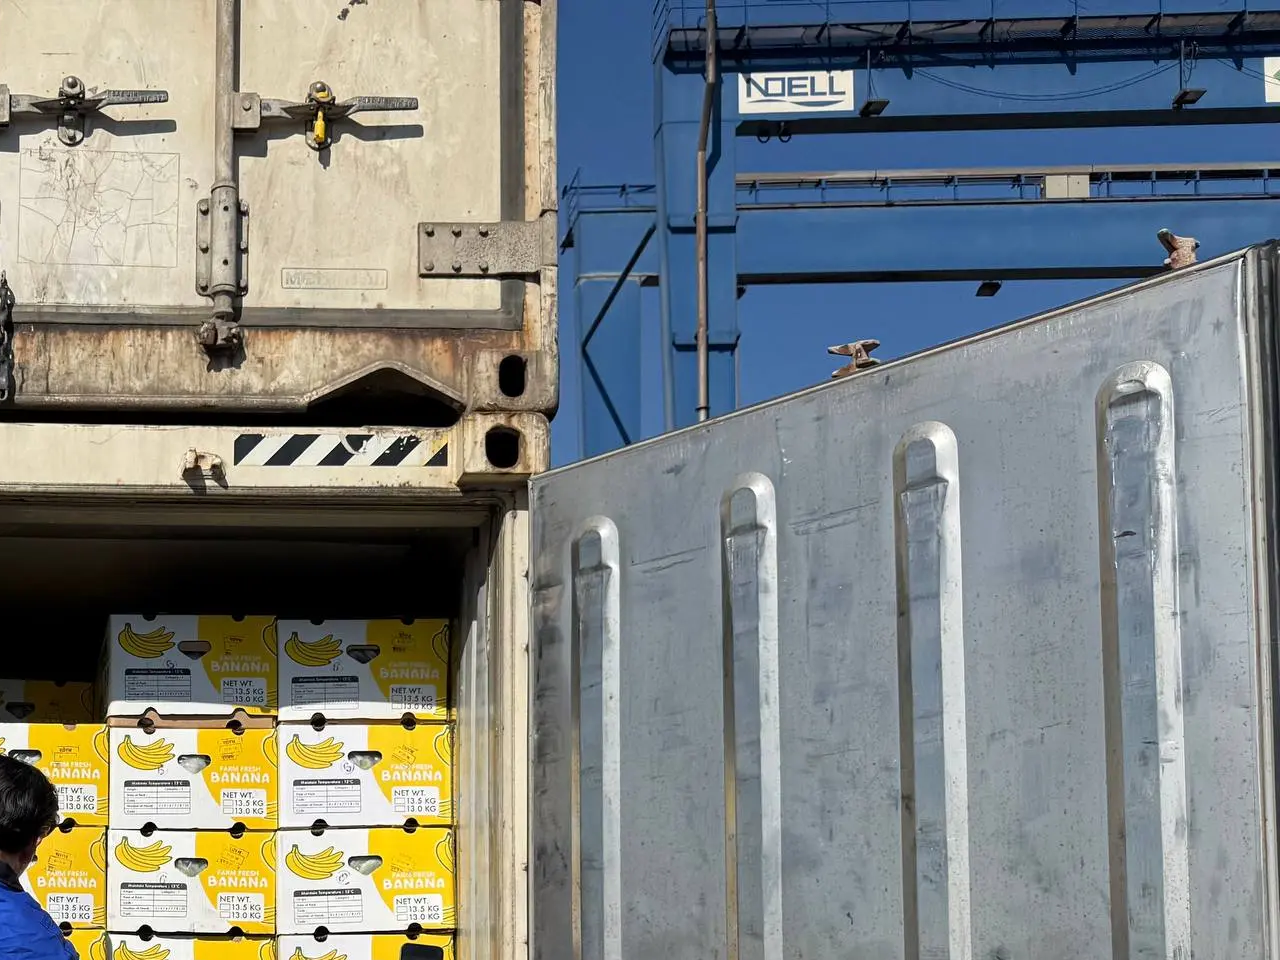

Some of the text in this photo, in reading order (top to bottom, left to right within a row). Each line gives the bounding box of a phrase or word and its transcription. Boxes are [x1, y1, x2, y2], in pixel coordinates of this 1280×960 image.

[746, 76, 846, 98] NOELL
[211, 661, 270, 674] BANANA
[253, 695, 264, 703] KG
[211, 772, 270, 784] BANANA
[381, 769, 443, 782] BANANA
[235, 799, 264, 807] 13.5 KG
[406, 797, 422, 805] 13.5
[235, 807, 264, 815] 13.0 KG
[406, 805, 437, 813] 13.0 KG
[37, 876, 97, 888] BANANA
[208, 875, 268, 888] BANANA
[382, 877, 446, 891] BANANA
[219, 895, 235, 903] NET
[232, 903, 247, 911] 13.5
[409, 905, 425, 913] 13.5
[409, 913, 426, 921] 13.0
